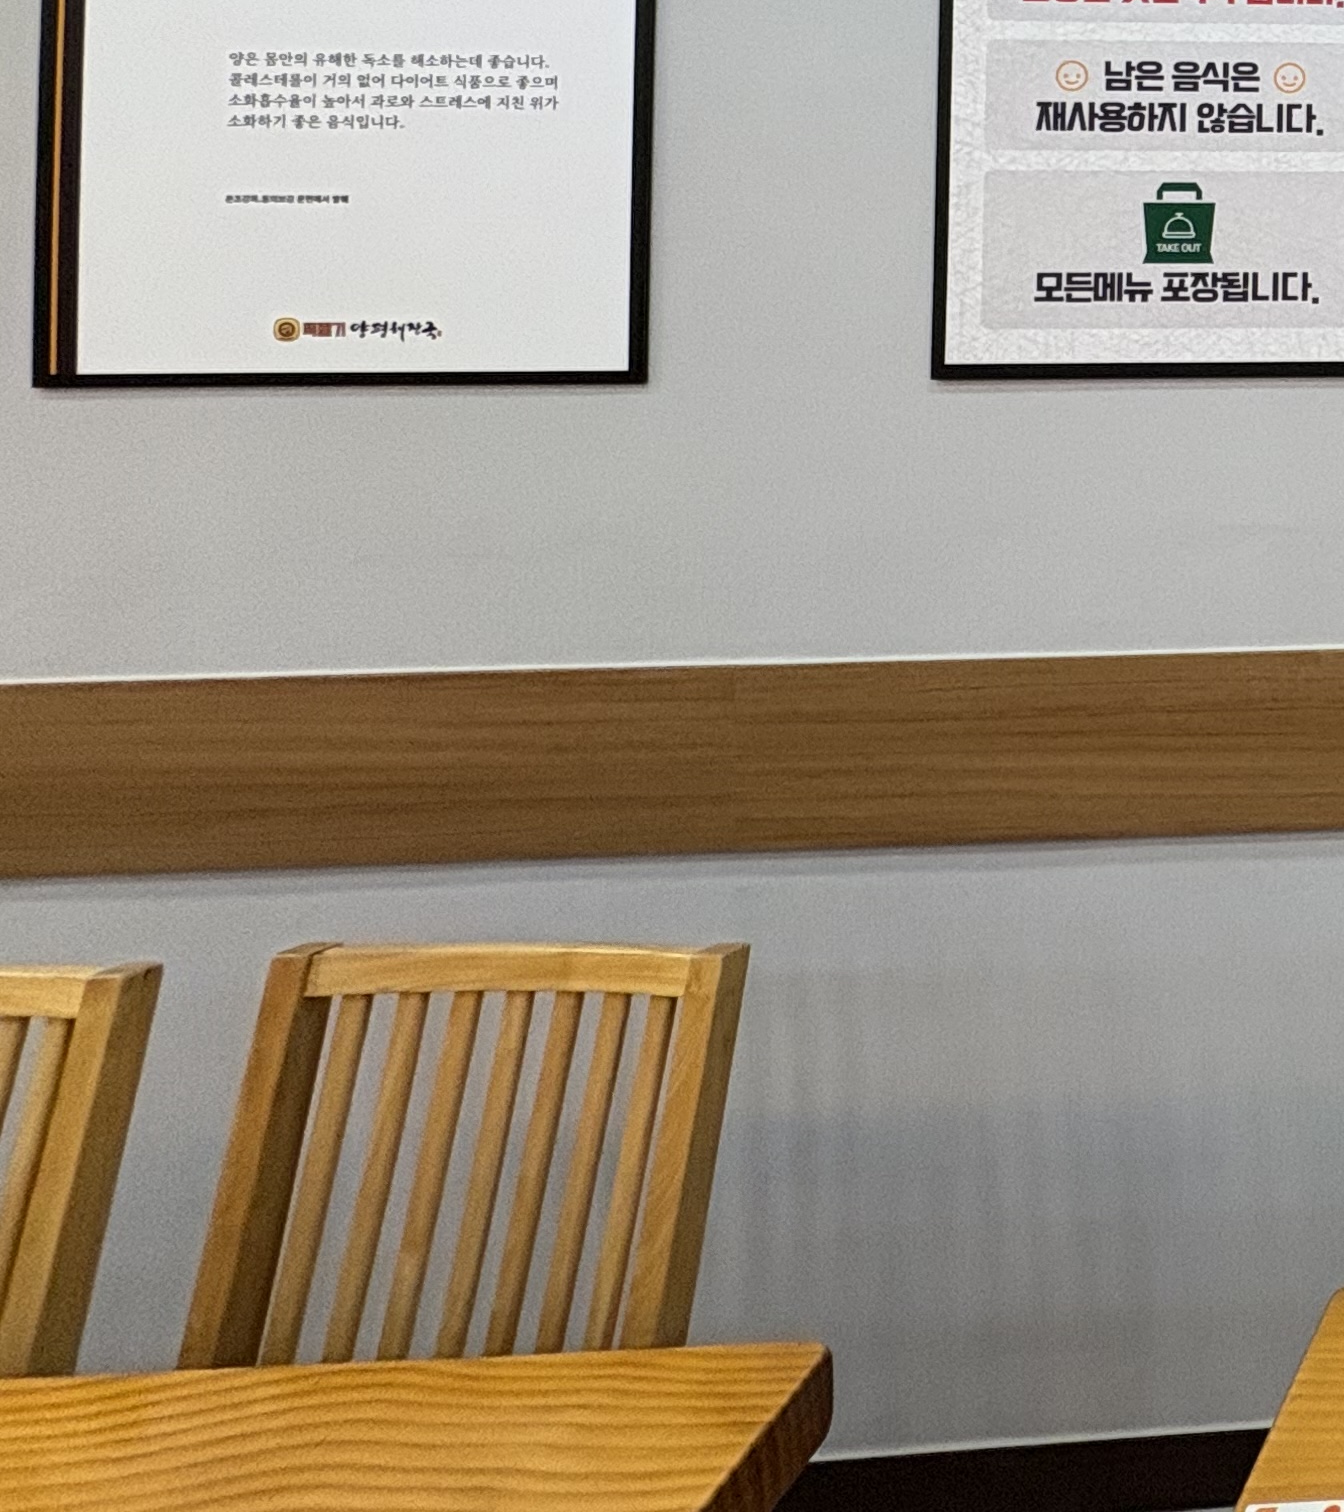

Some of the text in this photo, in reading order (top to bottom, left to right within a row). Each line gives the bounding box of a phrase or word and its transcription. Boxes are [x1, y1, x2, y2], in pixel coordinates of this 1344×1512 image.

[228, 51, 550, 70] 양은 몸안의 유해한 독소를 해소하는데 좋습니다.
[322, 72, 352, 89] 거의
[356, 72, 386, 89] 없어
[390, 73, 449, 89] 다이어트
[453, 73, 512, 90] 식품으로
[515, 74, 559, 91] 좋으며
[1104, 60, 1261, 93] 남은 음식은
[321, 93, 366, 109] 높아서
[370, 93, 415, 109] 과로와
[418, 94, 492, 110] 스트레스에
[496, 94, 525, 111] 지친
[529, 95, 560, 111] 위가
[226, 113, 406, 130] 소화하기 좋은 음식입니다.
[1035, 101, 1324, 137] 재사용하지 않습니다.
[1155, 242, 1202, 253] TAKE OUT
[1033, 271, 1320, 305] 모든메뉴 포장됩니다.
